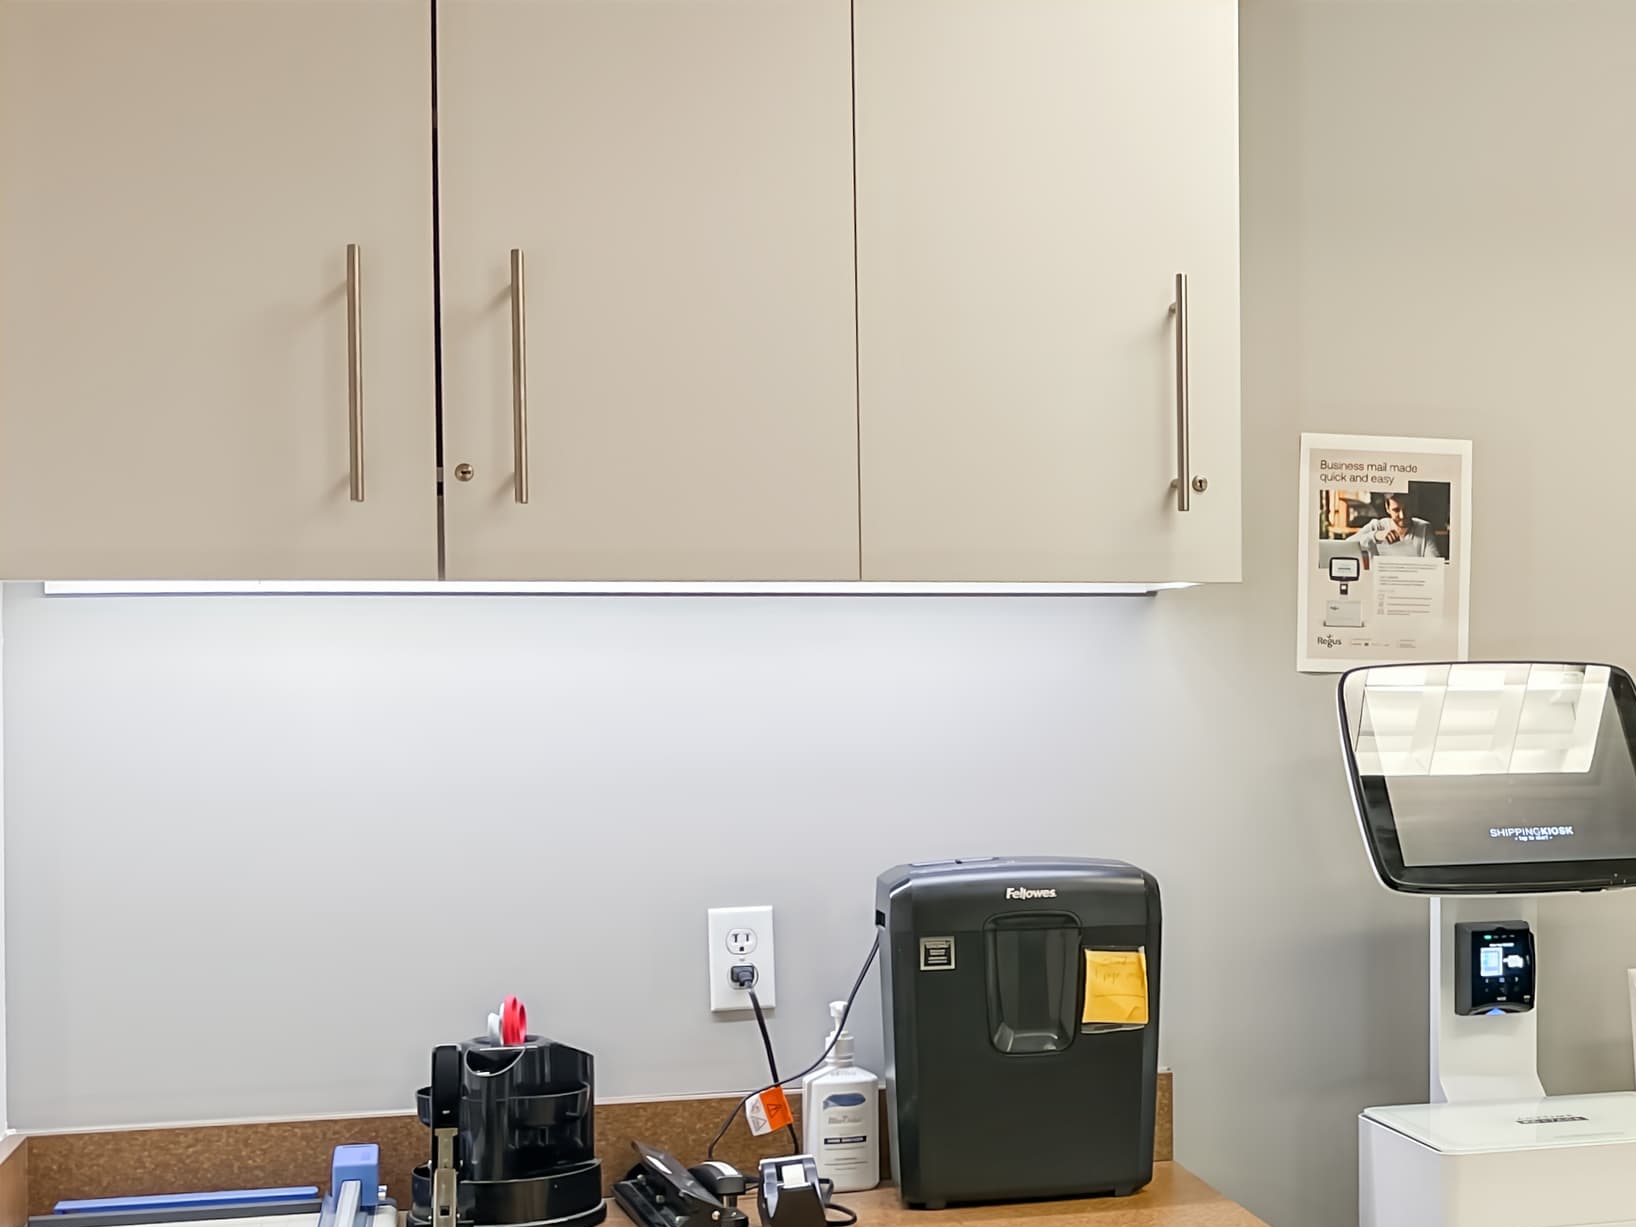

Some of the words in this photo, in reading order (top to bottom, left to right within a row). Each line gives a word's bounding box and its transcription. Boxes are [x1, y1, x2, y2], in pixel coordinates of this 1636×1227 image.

[1319, 459, 1365, 471] Business
[1366, 462, 1388, 472] mail
[1389, 463, 1418, 474] made
[1319, 472, 1347, 483] quick
[1349, 473, 1369, 483] and
[1370, 475, 1395, 486] easy
[1317, 636, 1342, 648] Regus
[1006, 886, 1057, 900] Fellowes
